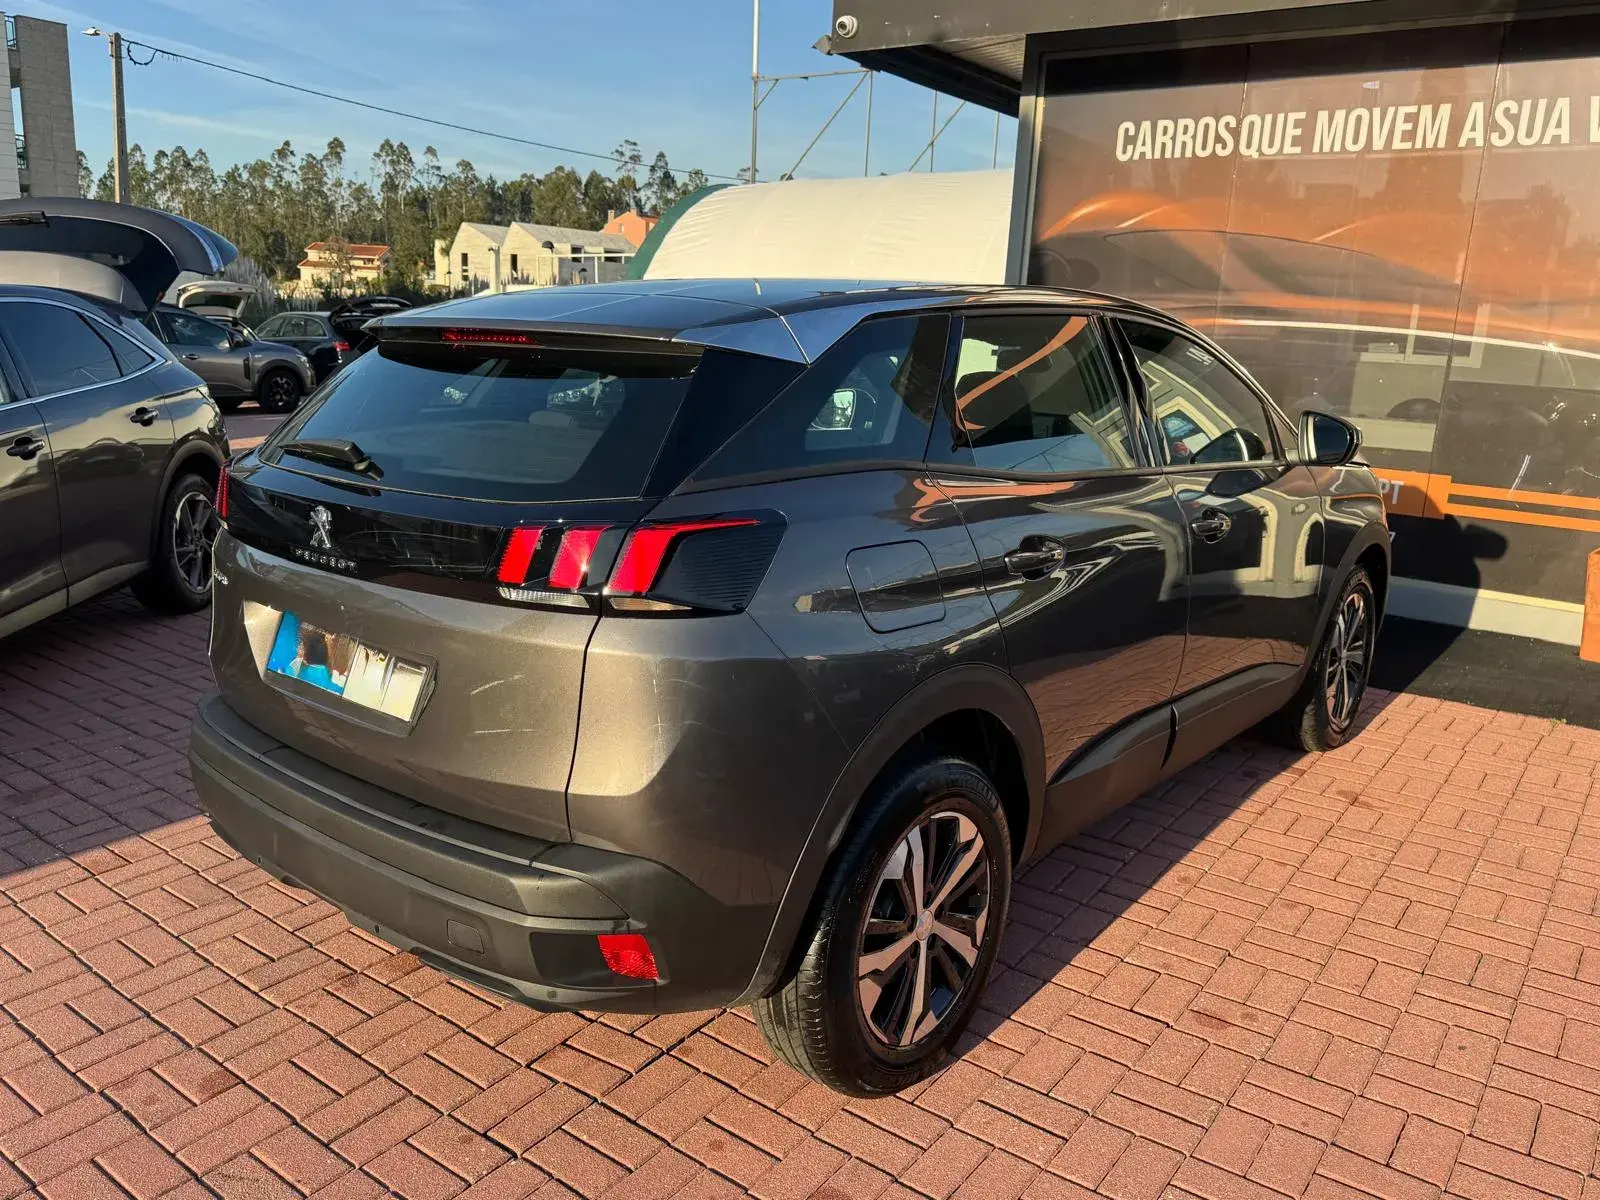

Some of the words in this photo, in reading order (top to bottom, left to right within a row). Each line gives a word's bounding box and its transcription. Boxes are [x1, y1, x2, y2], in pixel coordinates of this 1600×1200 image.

[1115, 115, 1237, 162] CARROS
[1238, 112, 1307, 160] QUE
[1312, 104, 1452, 154] MOVEM
[1458, 101, 1484, 149] A
[1490, 97, 1570, 147] SUA
[295, 549, 357, 571] PEUGEOT
